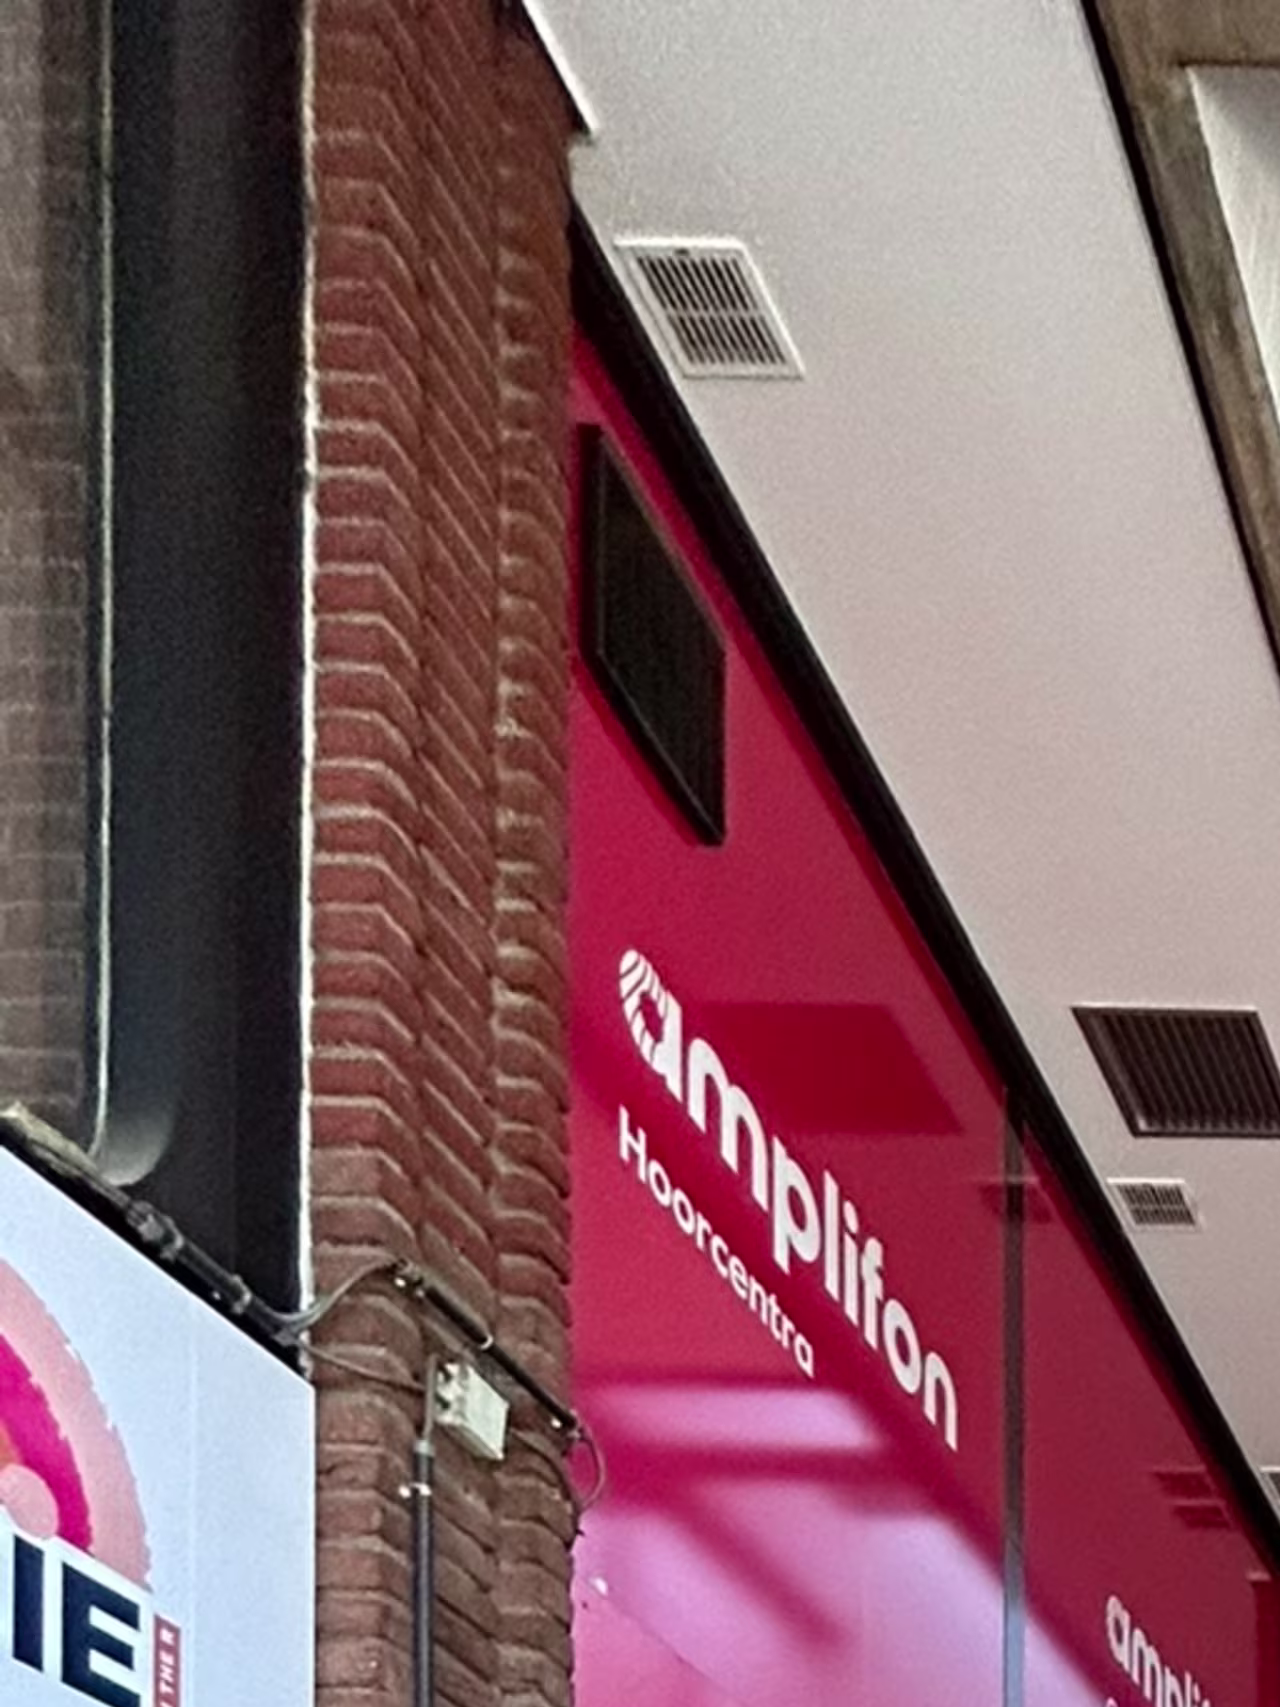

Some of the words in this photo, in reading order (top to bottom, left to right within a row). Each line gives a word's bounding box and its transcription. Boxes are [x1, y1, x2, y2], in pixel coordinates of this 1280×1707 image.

[619, 949, 958, 1452] amplifon
[619, 1104, 814, 1378] Hoorcentra
[159, 1650, 175, 1696] THE
